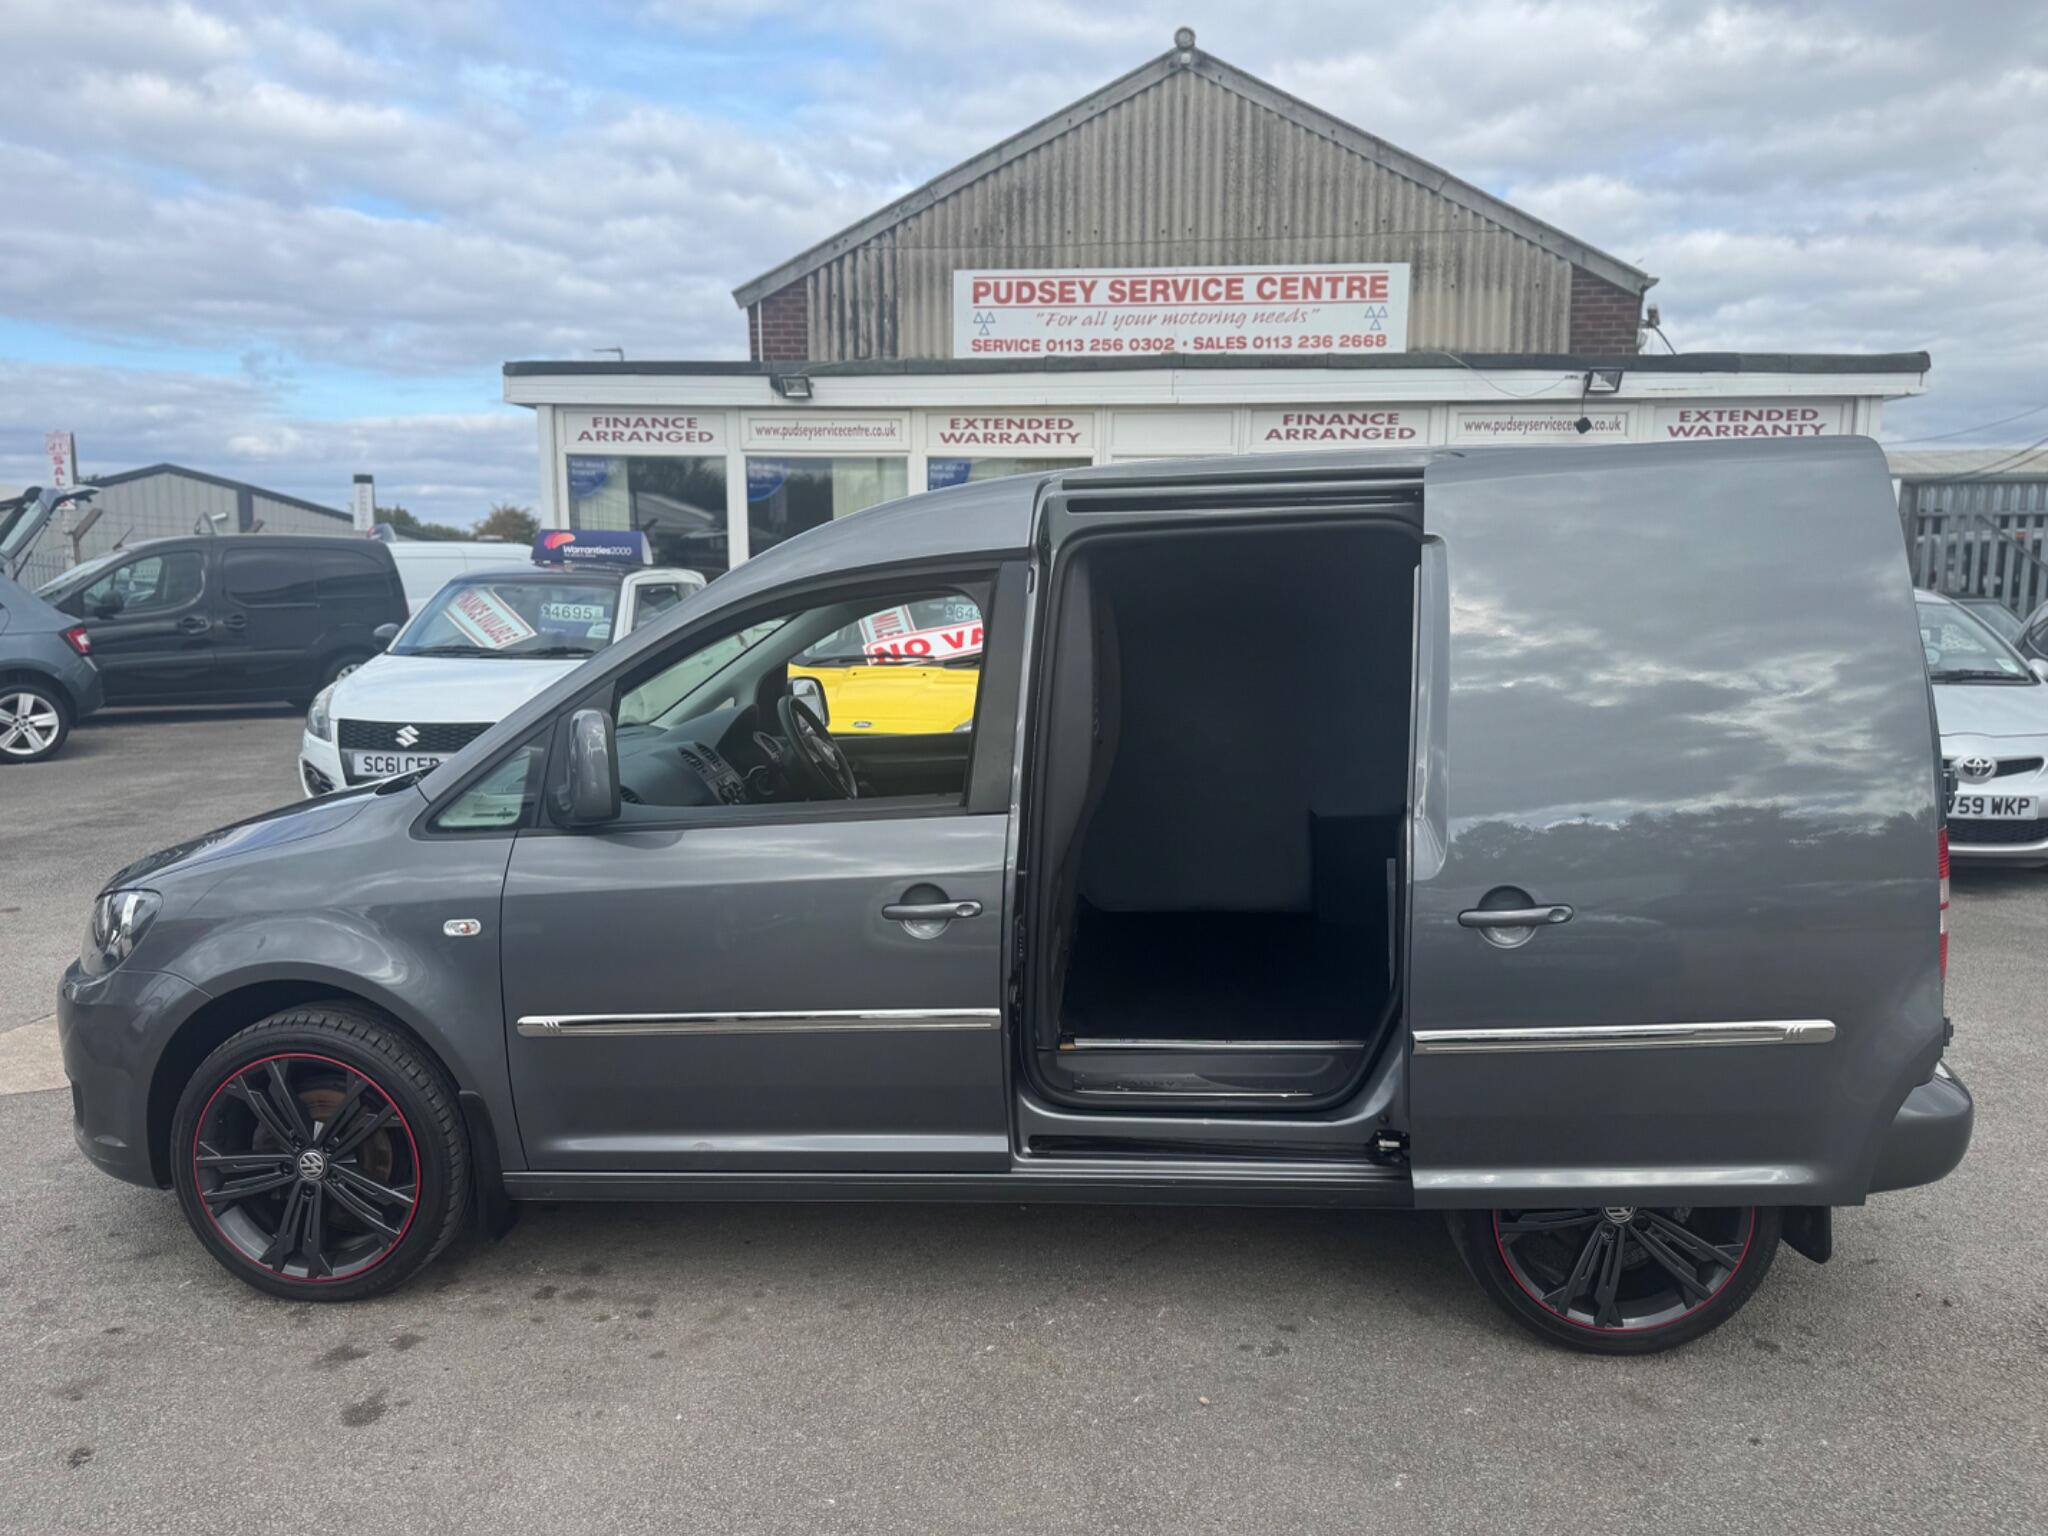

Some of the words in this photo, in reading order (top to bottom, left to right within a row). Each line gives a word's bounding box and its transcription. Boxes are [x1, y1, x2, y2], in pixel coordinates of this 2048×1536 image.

[973, 279, 1098, 304] PUDSEY
[1108, 277, 1244, 304] SERVICE
[1256, 275, 1389, 300] CENTRE
[1081, 311, 1108, 326] all
[1113, 313, 1158, 331] your
[1162, 310, 1248, 329] motoring
[971, 339, 1041, 352] SERVICE
[1046, 338, 1084, 352] 0113
[1090, 338, 1123, 351] 256
[1129, 337, 1175, 351] 0302
[1193, 336, 1247, 350] SALES
[1252, 336, 1293, 349] 0113
[1299, 335, 1333, 349] 236
[1339, 334, 1387, 348] 2668
[592, 416, 698, 429] FINANCE
[1282, 412, 1400, 426] FINANCE
[1678, 408, 1819, 423] EXTENDED
[755, 421, 896, 440] www.pudseyservicecentre.co.uk
[950, 417, 1074, 430] EXTENDED
[1464, 416, 1621, 435] www.pudseyservicece.co.uk
[1666, 423, 1827, 438] WARRANTY
[577, 430, 714, 443] ARRANGED
[939, 431, 1081, 444] WARRANTY
[1264, 427, 1416, 441] ARRANGED
[874, 638, 931, 664] NO
[1991, 798, 2030, 816] WKP
